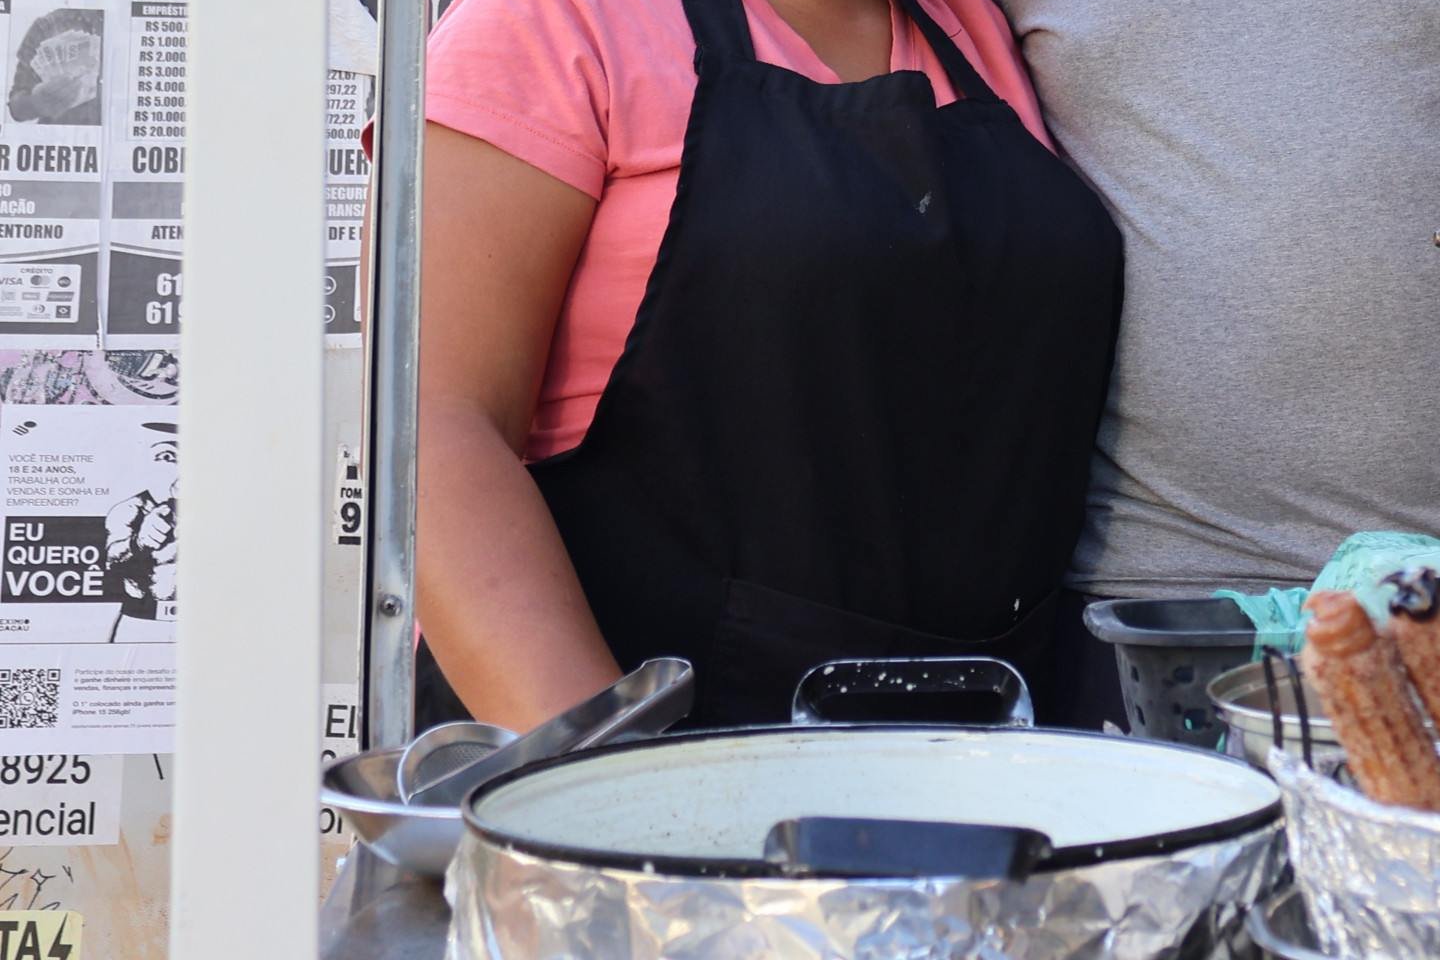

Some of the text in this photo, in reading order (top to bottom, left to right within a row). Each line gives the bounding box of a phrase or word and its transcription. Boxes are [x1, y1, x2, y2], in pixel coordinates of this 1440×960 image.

[17, 144, 98, 173] OFERTA
[8, 452, 95, 463] VOCÊ TEM ENTRE
[9, 465, 21, 474] 18
[22, 465, 30, 474] E
[31, 465, 43, 474] 24
[8, 476, 86, 485] TRABALHA COM
[6, 487, 110, 496] VENDAS E SONHA EM
[6, 498, 79, 507] EMPREENDER?
[9, 522, 44, 541] EU
[7, 545, 100, 565] QUERO
[5, 564, 105, 597] VOCÊ
[0, 754, 91, 785] 8925
